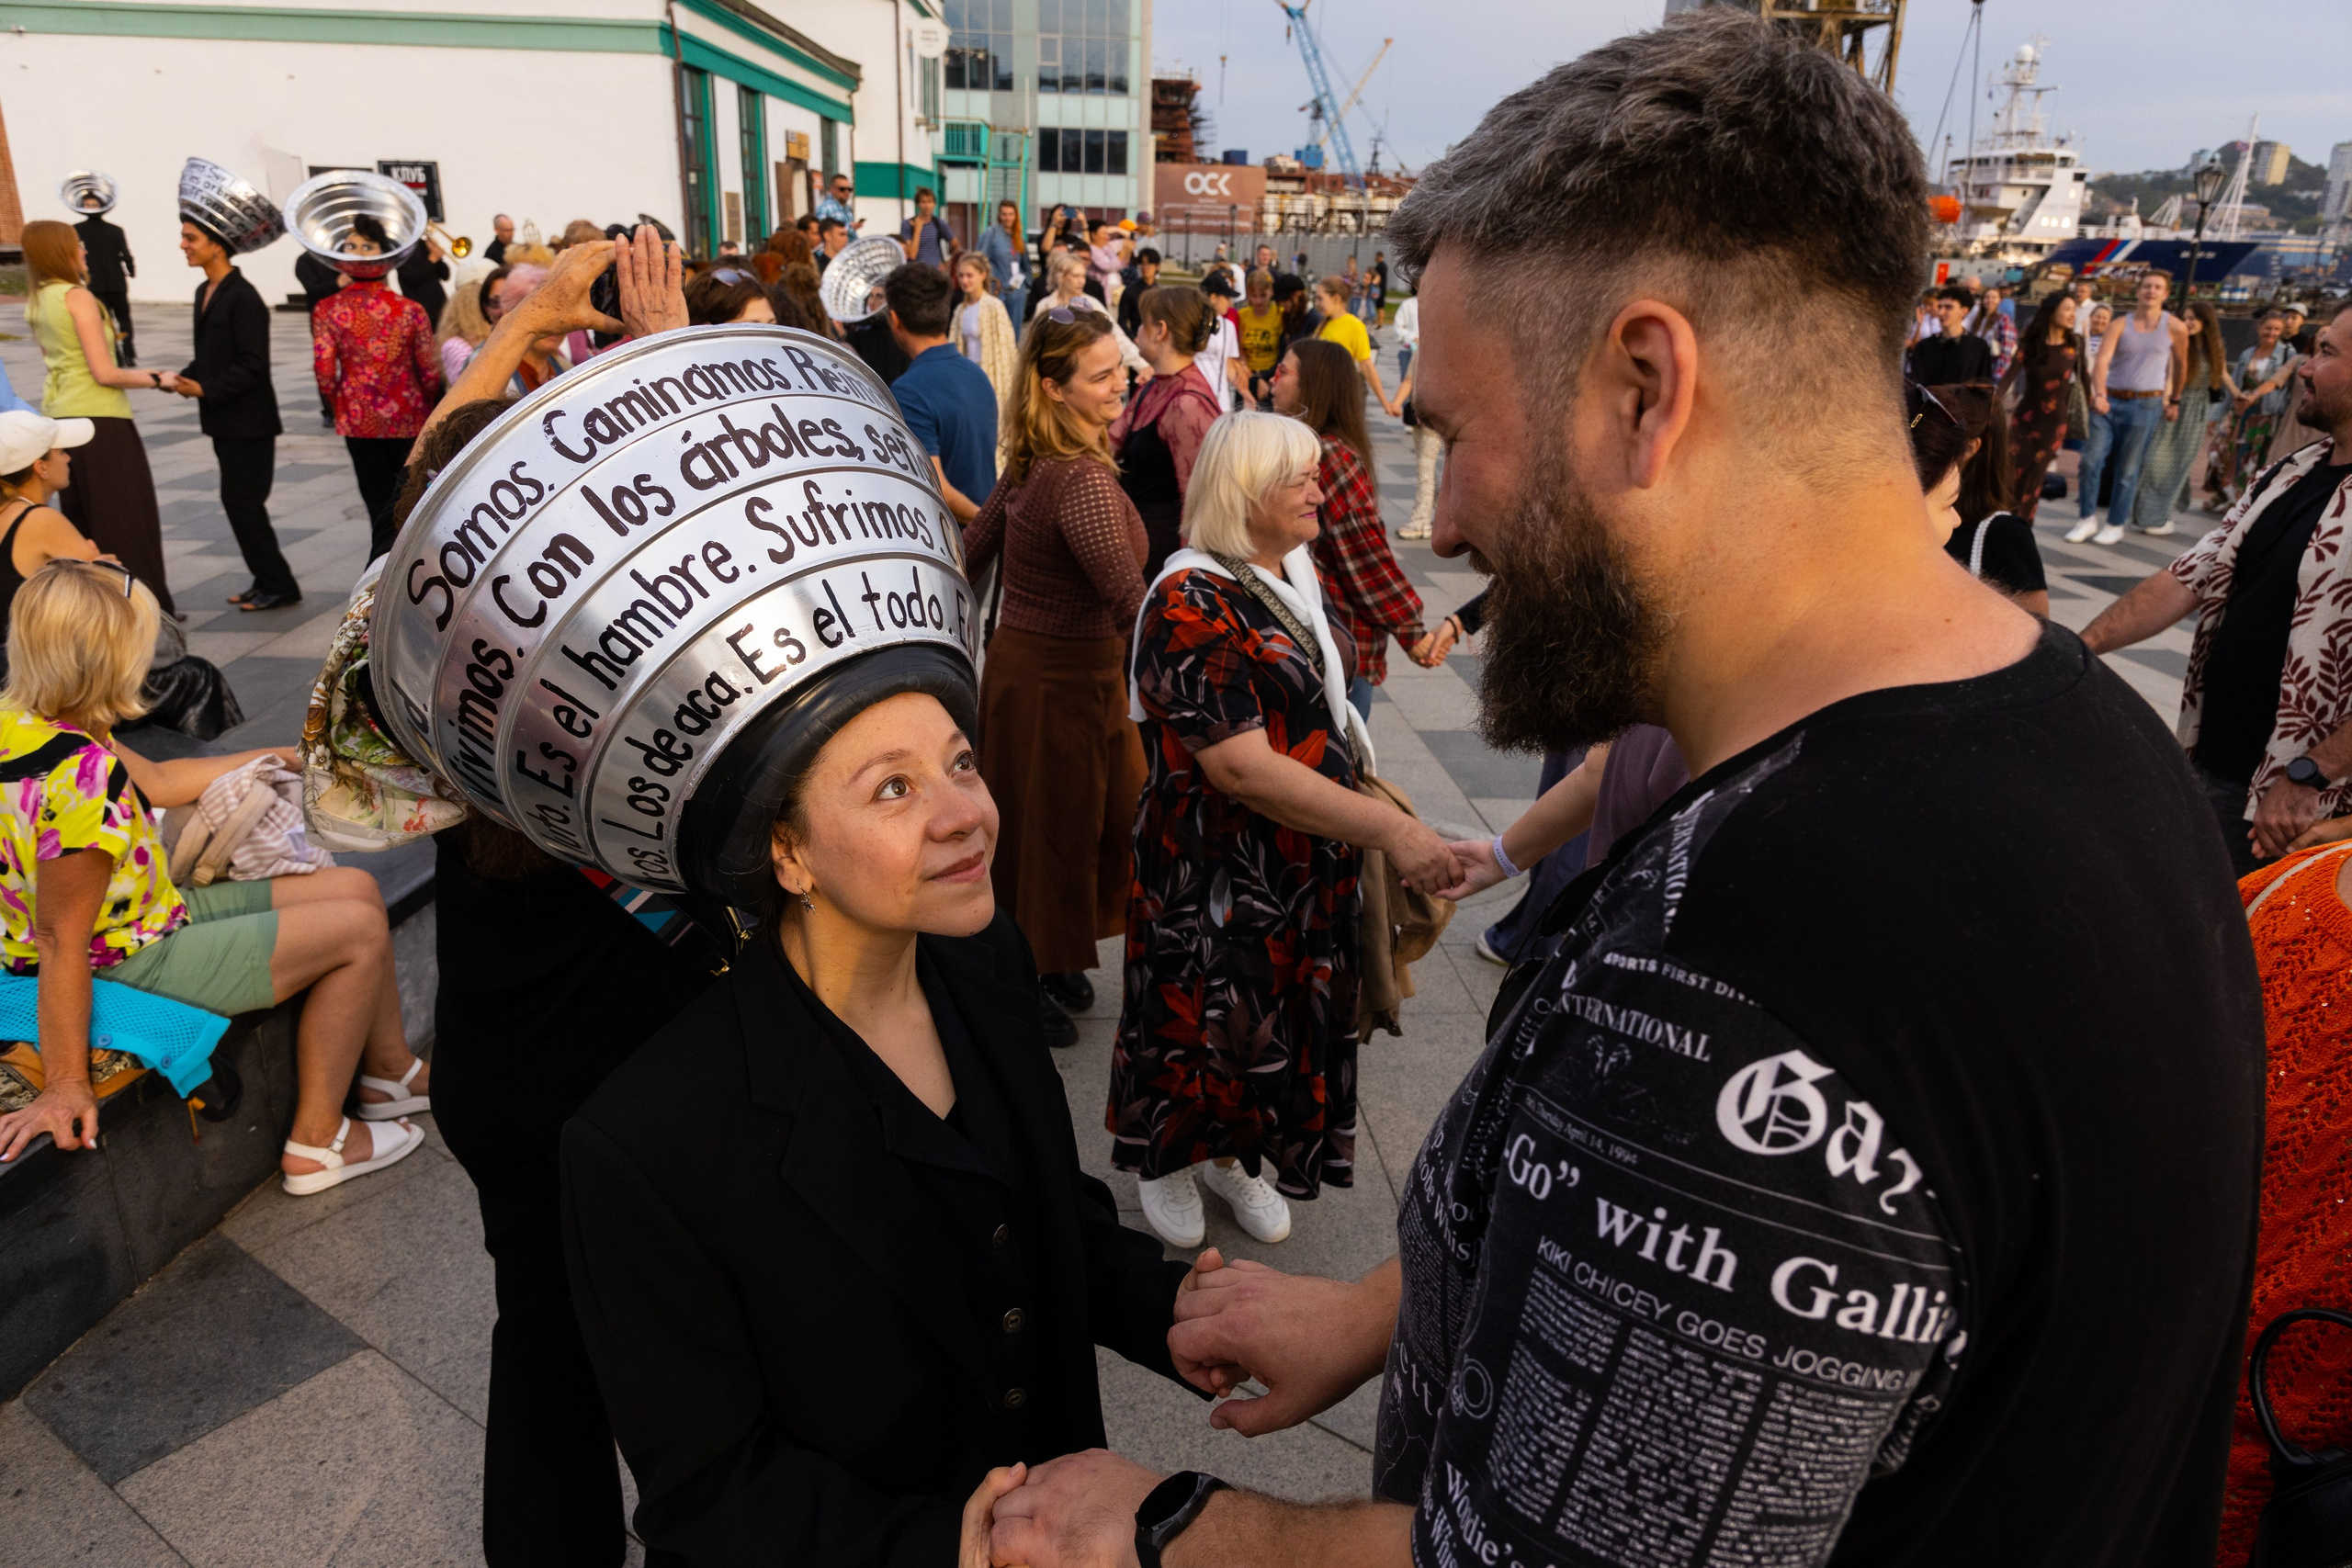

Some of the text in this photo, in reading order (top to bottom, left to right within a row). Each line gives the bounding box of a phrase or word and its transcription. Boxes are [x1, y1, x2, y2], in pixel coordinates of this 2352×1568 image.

[390, 165, 427, 183] КЛУБ
[407, 461, 555, 632] Somos.
[542, 358, 803, 464] Caminamos.
[492, 533, 595, 628] Con
[581, 474, 676, 536] los
[680, 402, 866, 491] árboles,
[745, 479, 946, 564] Sufrimos.
[560, 540, 757, 691] hambre.
[539, 678, 600, 738] el
[602, 775, 671, 840] Los
[726, 623, 806, 685] Es
[812, 579, 856, 649] el
[861, 566, 953, 634] todo.
[516, 741, 577, 799] Es
[1661, 962, 1712, 991] FIRST
[1596, 1197, 1738, 1293] with
[1537, 1235, 1573, 1274] KIKI
[1574, 1261, 1673, 1321] CHICEY
[1677, 1310, 1768, 1359] GOES
[1772, 1345, 1905, 1392] JOGGING
